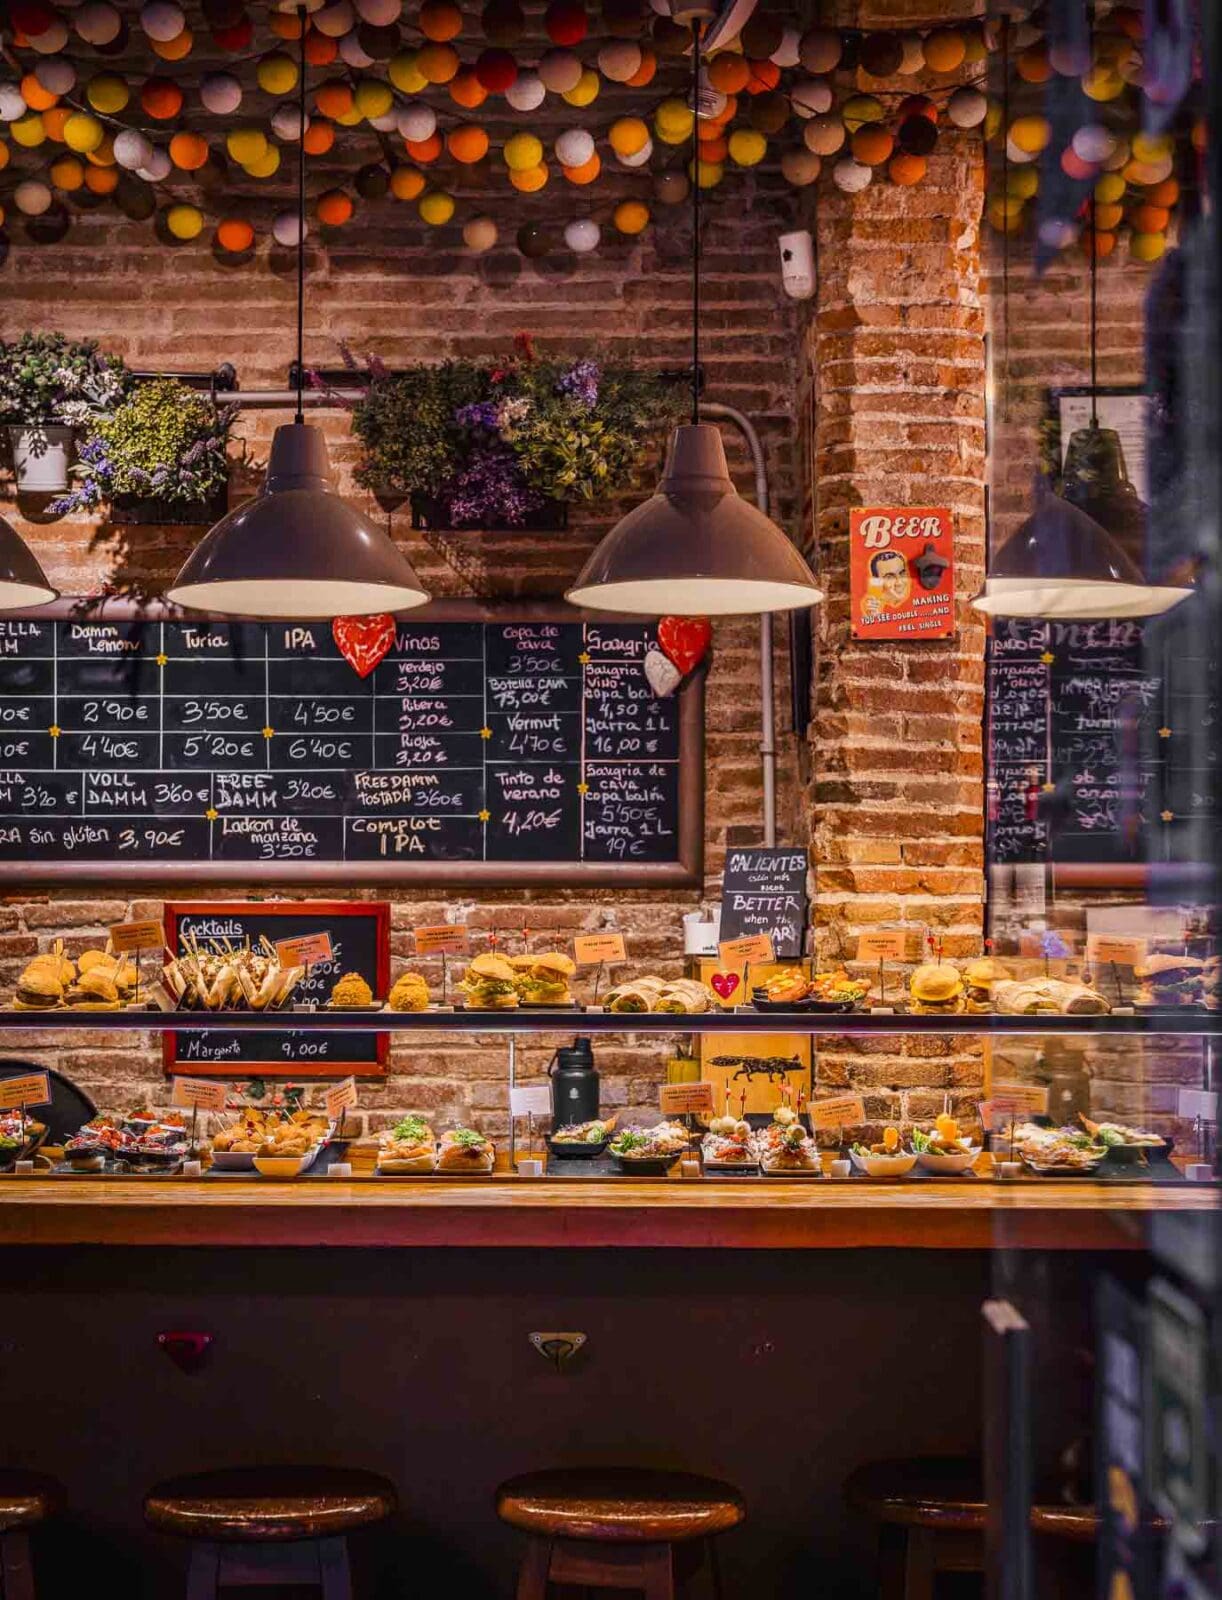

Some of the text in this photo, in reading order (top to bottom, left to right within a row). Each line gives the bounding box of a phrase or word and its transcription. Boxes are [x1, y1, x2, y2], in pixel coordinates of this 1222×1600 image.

[860, 515, 942, 548] BEER
[912, 595, 950, 606] MAKING
[861, 614, 875, 625] YOU
[878, 613, 890, 622] SEE
[892, 611, 918, 622] DOUBLE
[71, 624, 118, 640] Damm
[181, 629, 229, 649] Turia
[284, 630, 316, 649] IPA
[83, 701, 149, 721] 2'90€
[181, 700, 249, 723] 3'50€
[294, 701, 355, 722] 4'50€
[507, 712, 562, 731] Vermut
[82, 735, 139, 758] 4'40€
[183, 732, 254, 757] 5'20€
[289, 738, 352, 758] 6'40€
[89, 773, 136, 787] VOLL
[216, 774, 274, 789] FREE
[543, 768, 565, 784] de
[87, 790, 147, 806] DAMM
[215, 779, 336, 809] DAMM 3'20€
[281, 817, 299, 832] de
[118, 829, 185, 850] 3,90€
[733, 895, 799, 911] BETTER
[744, 914, 769, 925] when
